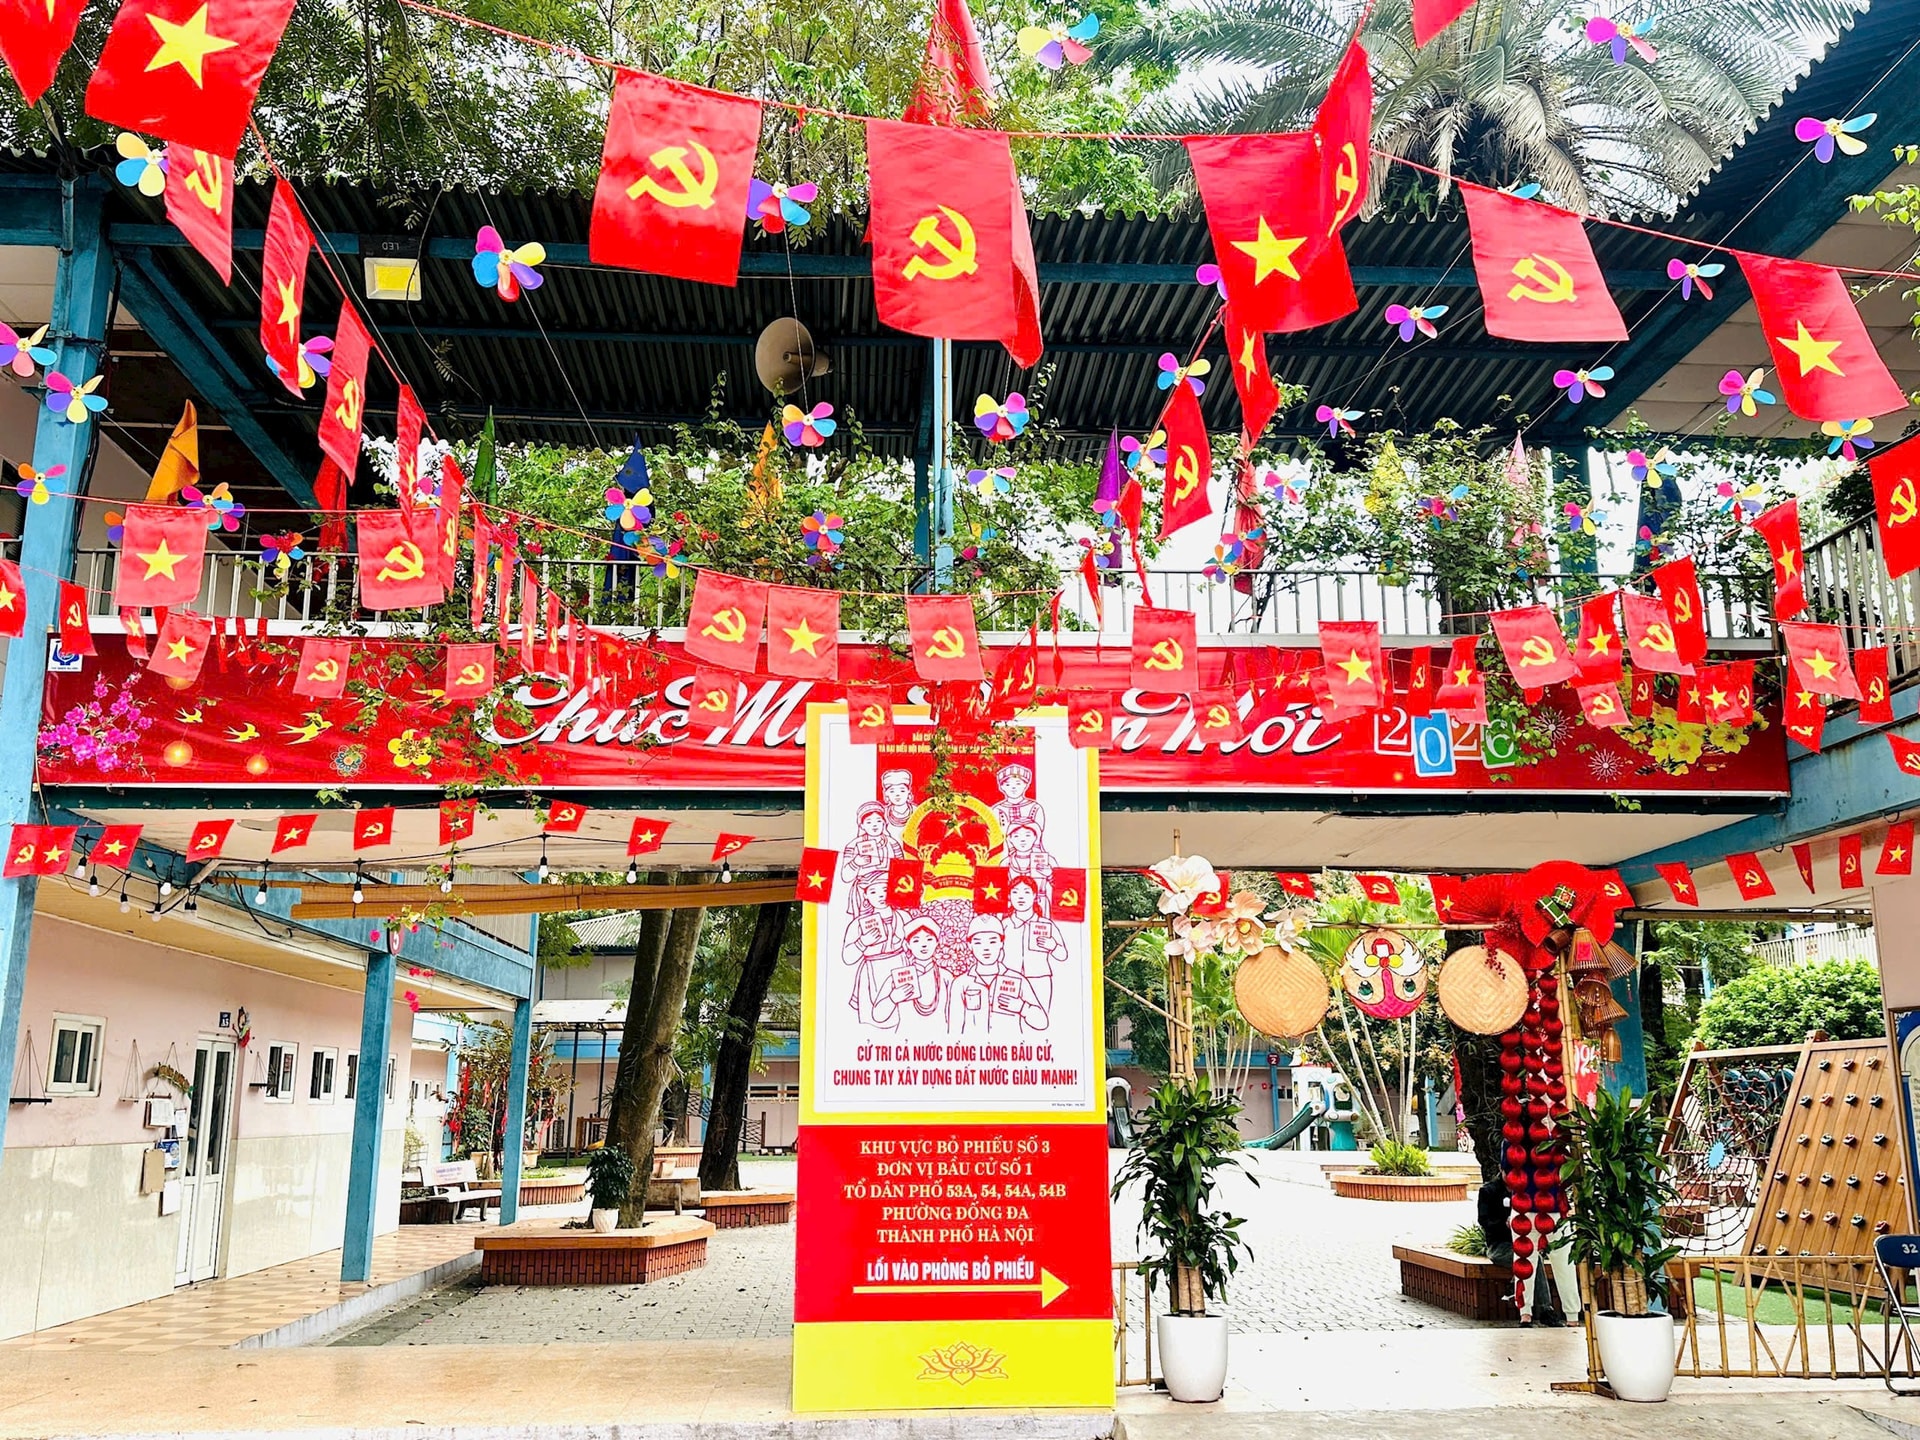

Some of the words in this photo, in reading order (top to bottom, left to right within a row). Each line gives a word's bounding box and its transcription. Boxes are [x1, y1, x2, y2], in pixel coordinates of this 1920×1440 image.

[381, 241, 400, 251] LED
[1380, 706, 1515, 767] 2026
[857, 1039, 873, 1062] CỬ
[875, 1045, 892, 1062] TRI
[895, 1039, 910, 1062] CẢ
[913, 1041, 943, 1062] NƯỚC
[946, 1040, 976, 1062] ĐỒNG
[980, 1041, 1008, 1062] LÒNG
[1011, 1040, 1033, 1062] BẦU
[1036, 1038, 1054, 1063] CỬ,
[833, 1069, 871, 1086] CHUNG
[874, 1069, 894, 1086] TAY
[898, 1066, 919, 1086] XÂY
[922, 1068, 952, 1089] DỰNG
[955, 1063, 976, 1085] ĐẤT
[979, 1064, 1009, 1086] NƯỚC
[1012, 1066, 1038, 1086] GIÀU
[1041, 1069, 1078, 1089] MẠNH!
[860, 1140, 896, 1155] KHU
[899, 1140, 933, 1158] VỰC
[936, 1134, 959, 1154] BỎ
[963, 1135, 1013, 1154] PHIẾU
[1017, 1135, 1039, 1154] SỐ
[1041, 1140, 1050, 1153] 3
[877, 1161, 913, 1176] ĐƠN
[916, 1162, 934, 1179] VỊ
[937, 1156, 970, 1176] BẦU
[974, 1157, 998, 1176] CỬ
[1000, 1156, 1022, 1176] SỐ
[1025, 1162, 1033, 1176] 1
[843, 1177, 867, 1199] TỔ
[870, 1180, 904, 1198] DÂN
[909, 1178, 943, 1198] PHỐ
[946, 1184, 978, 1200] 53A,
[980, 1184, 1001, 1200] 54,
[1004, 1184, 1036, 1200] 54A,
[1039, 1183, 1067, 1198] 54B
[882, 1201, 953, 1221] PHƯỜNG
[956, 1201, 1003, 1220] ĐỐNG
[1006, 1206, 1030, 1220] ĐA
[877, 1225, 934, 1243] THÀNH
[939, 1223, 973, 1243] PHỐ
[977, 1225, 1000, 1242] HÀ
[1004, 1224, 1035, 1246] NỘI
[1901, 1243, 1919, 1254] 32
[866, 1256, 889, 1281] LỐI
[891, 1258, 919, 1281] VÀO
[921, 1257, 969, 1281] PHÒNG
[972, 1255, 991, 1280] BỎ
[993, 1255, 1035, 1280] PHIẾU
